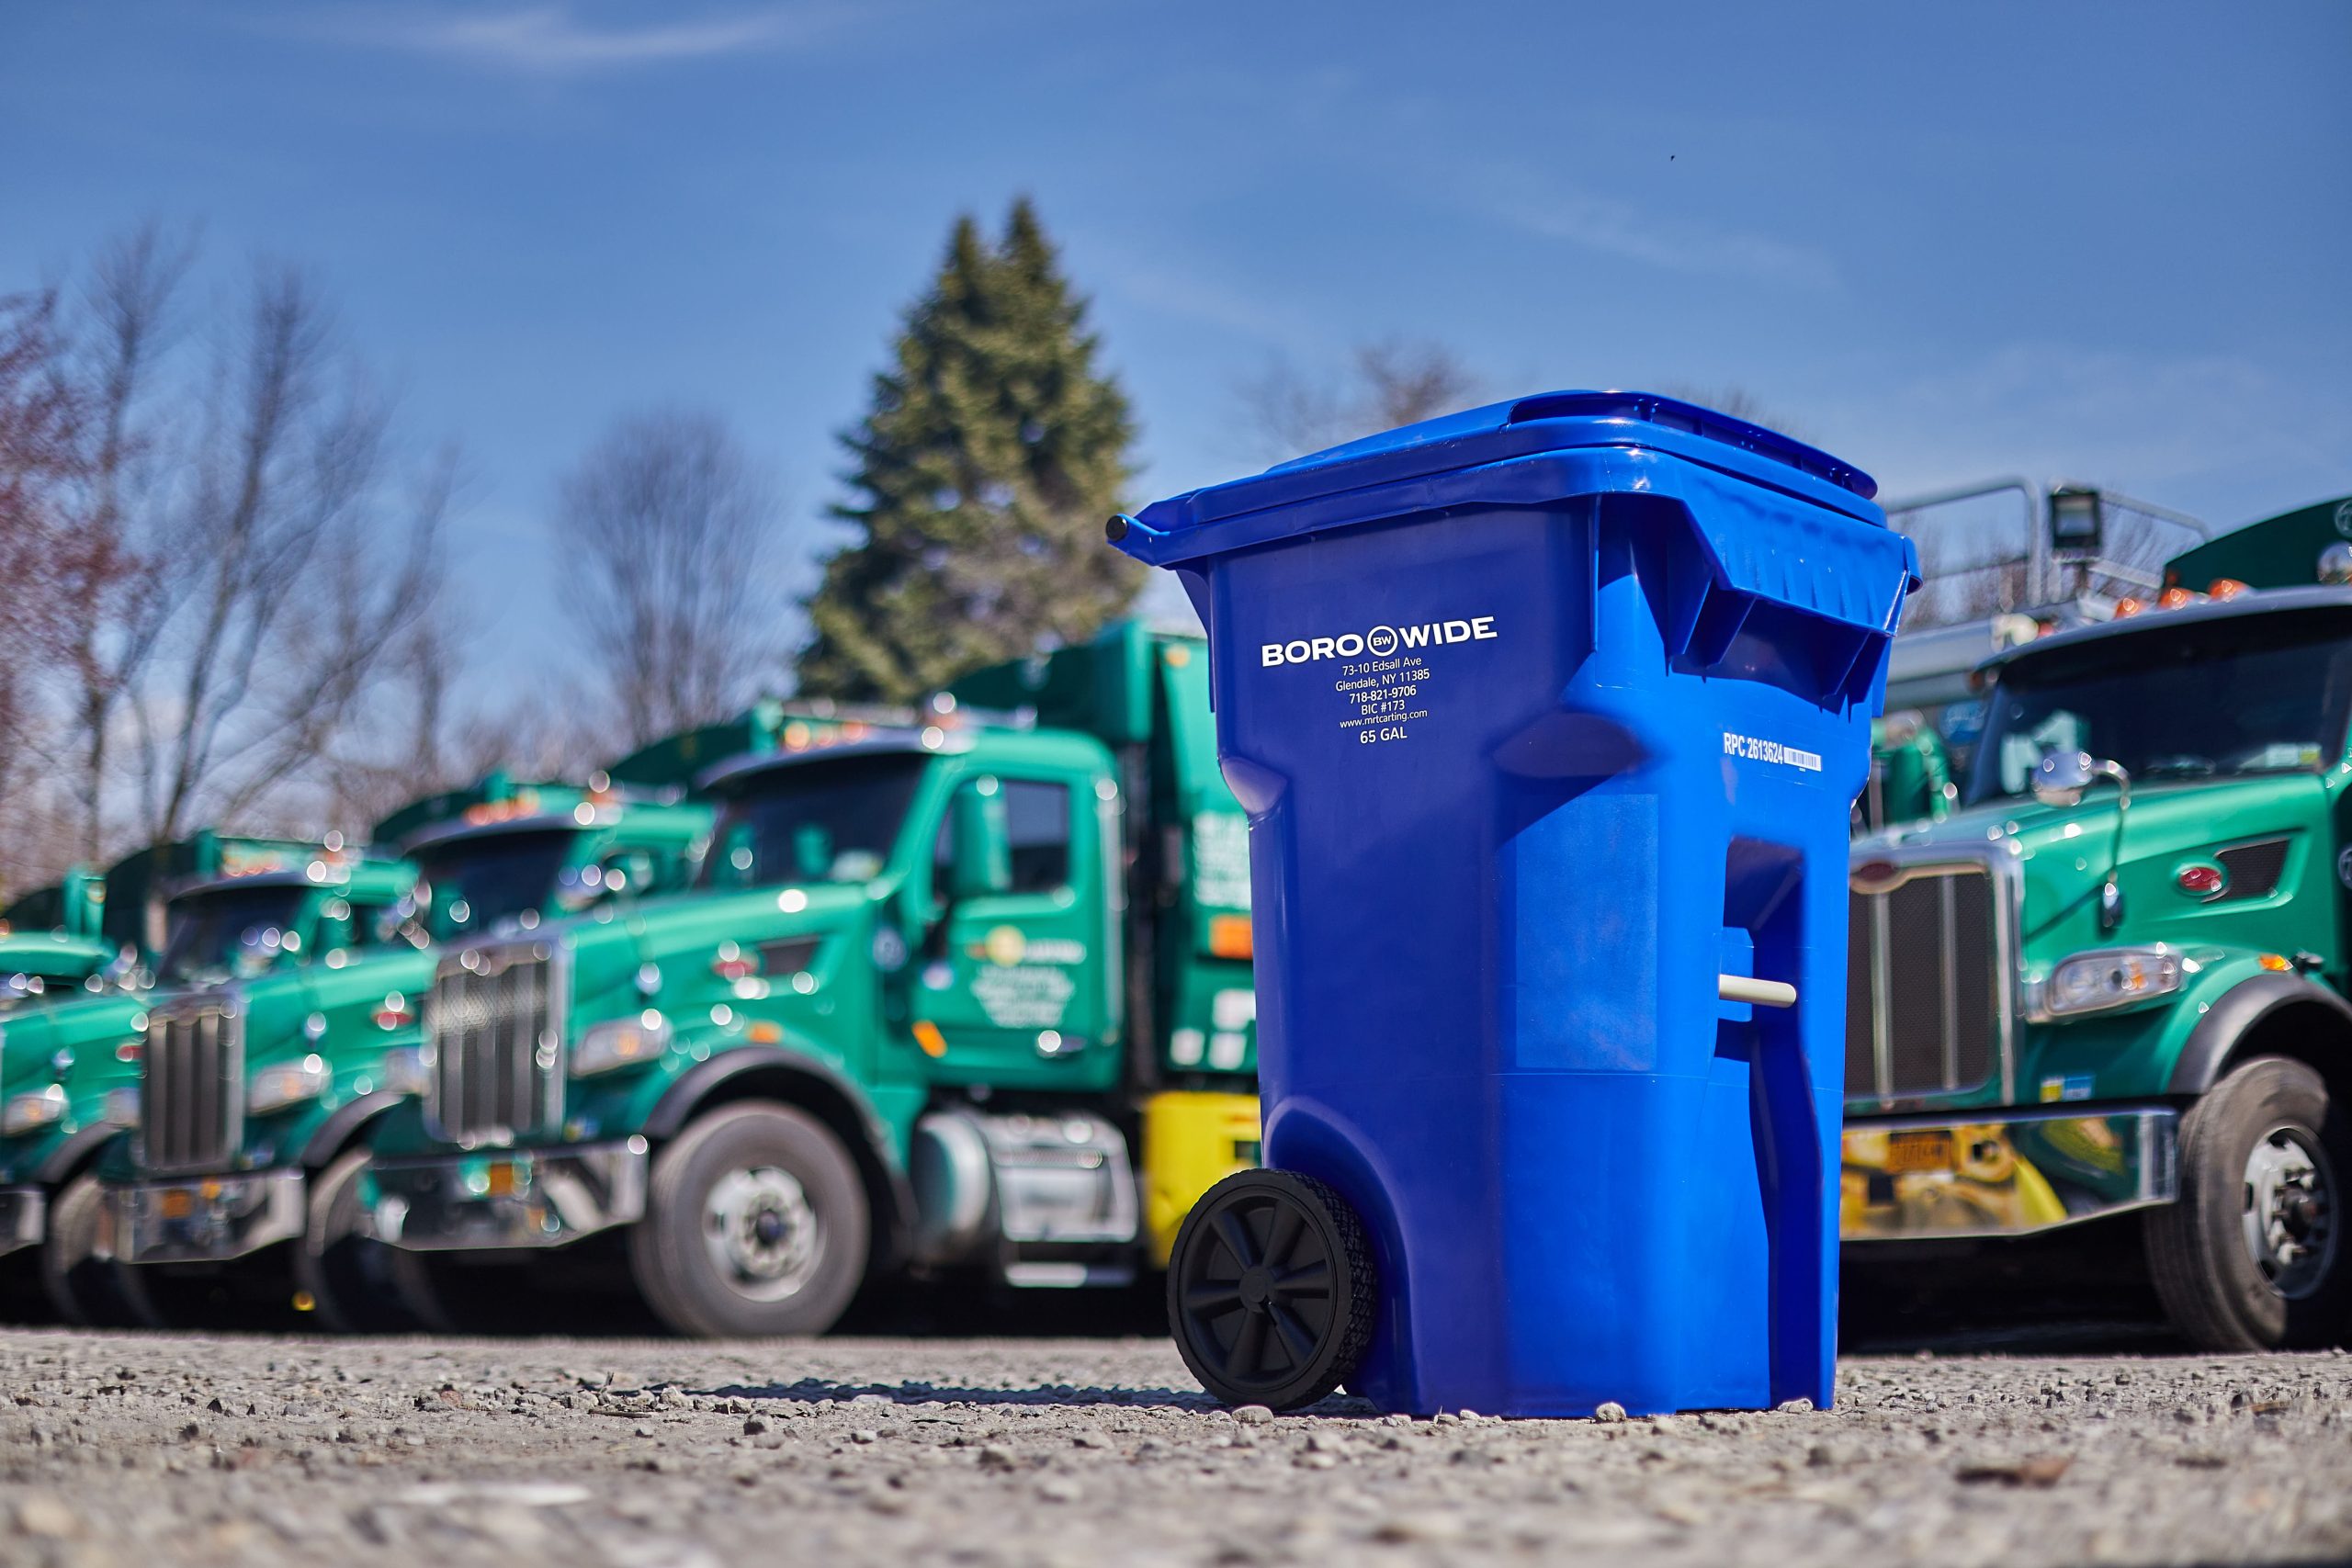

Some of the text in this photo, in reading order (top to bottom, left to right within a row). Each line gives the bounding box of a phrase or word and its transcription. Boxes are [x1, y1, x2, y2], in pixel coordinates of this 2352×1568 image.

[1261, 615, 1498, 667] BORO BW WIDE
[1342, 657, 1422, 676] 73-10 Edsall Ave
[1335, 669, 1430, 692] Glendale, NY 11385
[1350, 684, 1417, 705] 718-821-9706
[1340, 708, 1428, 728] www.mrtcarting.com
[1361, 700, 1405, 716] BIC #173
[1360, 726, 1408, 744] 65 GAL
[1724, 732, 1783, 764] RPC 2613624
